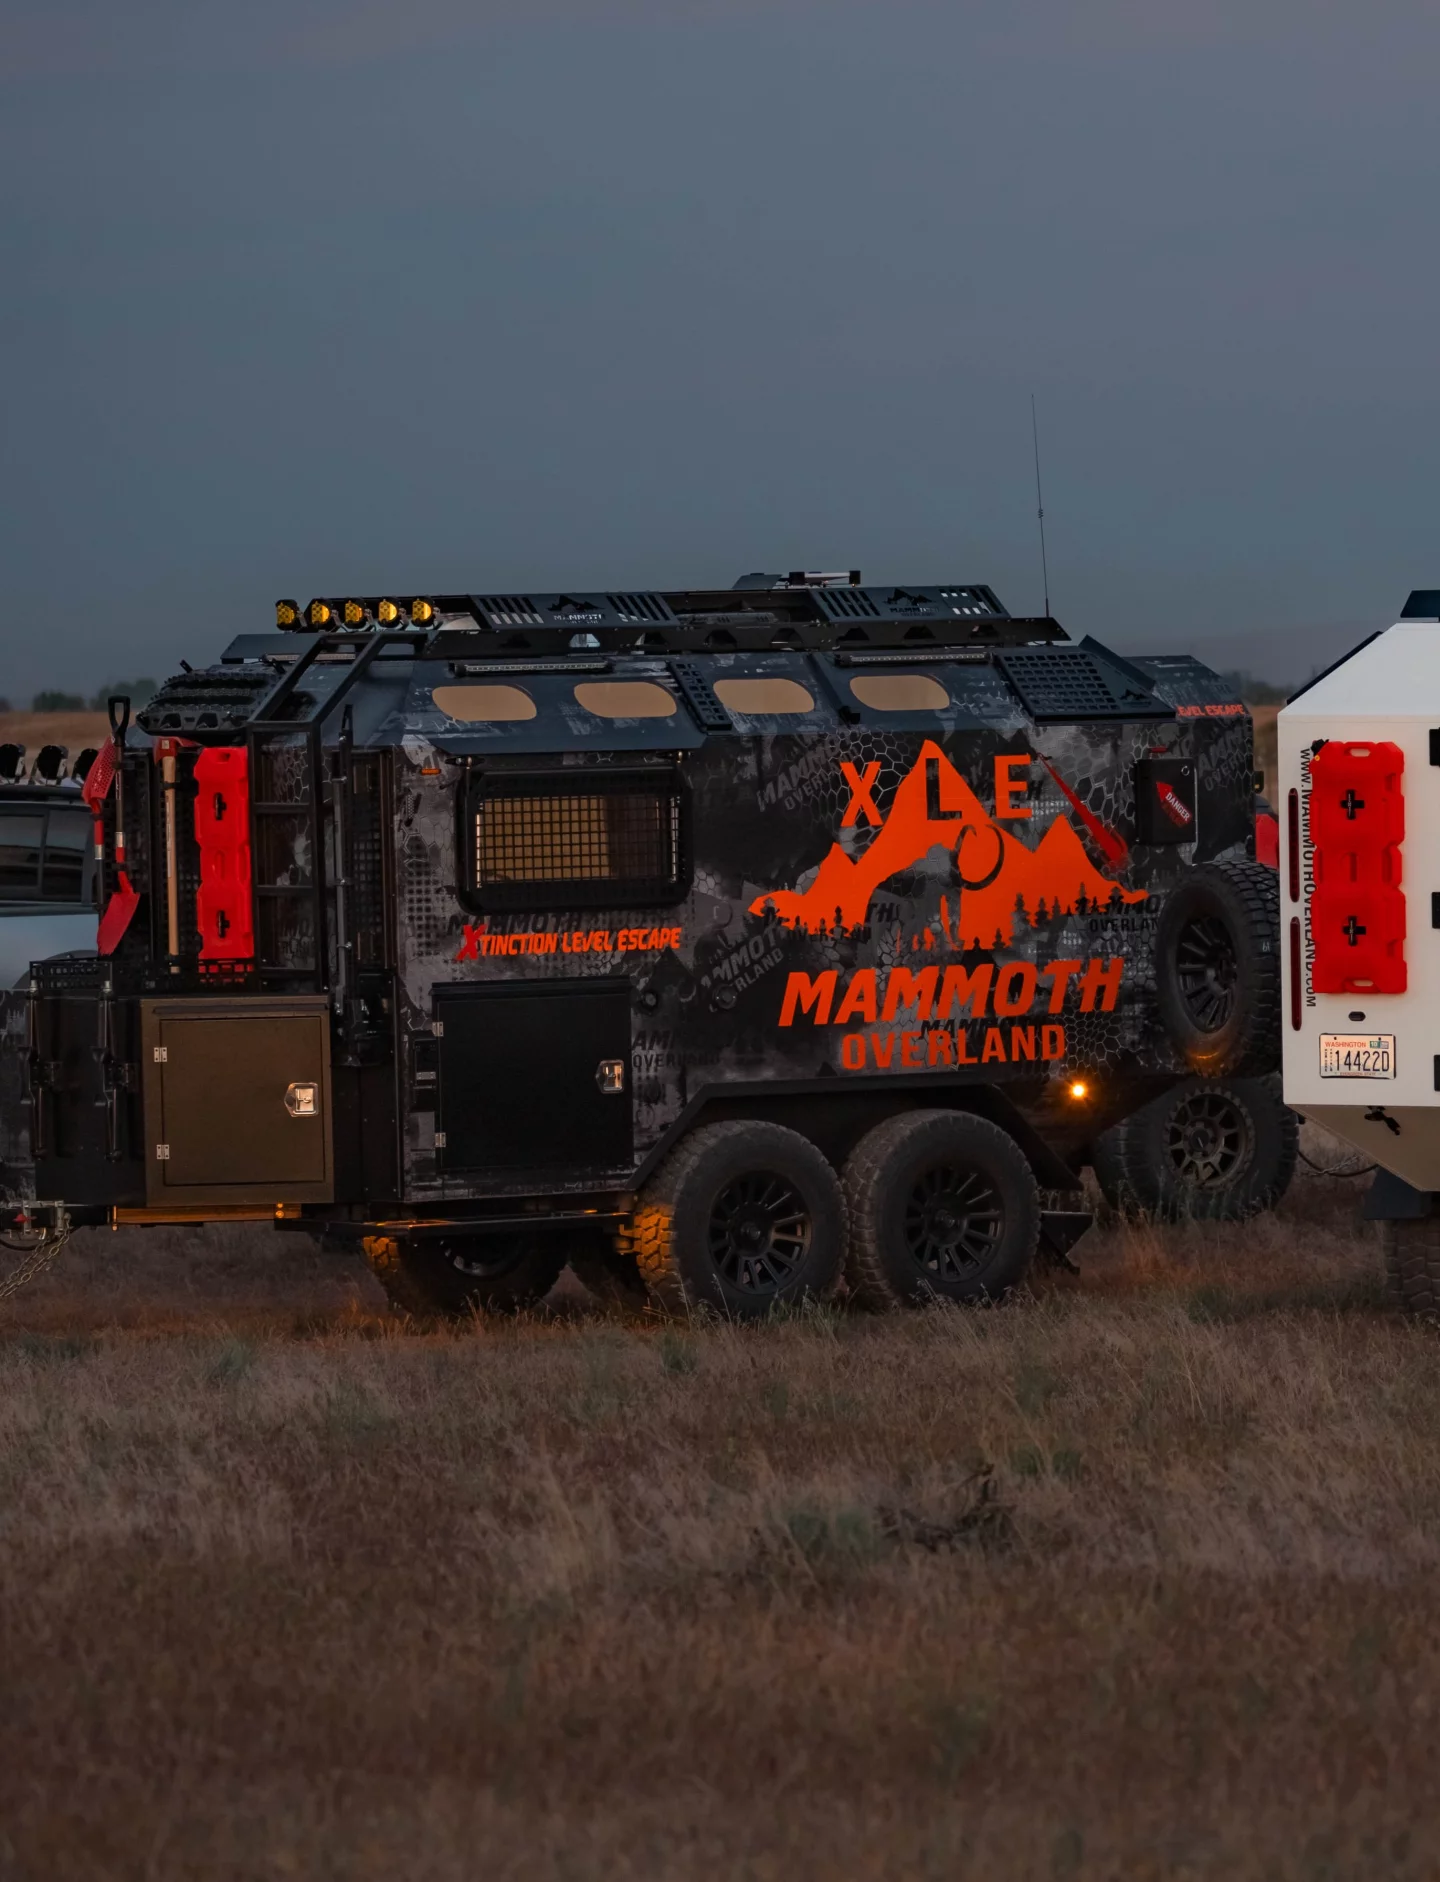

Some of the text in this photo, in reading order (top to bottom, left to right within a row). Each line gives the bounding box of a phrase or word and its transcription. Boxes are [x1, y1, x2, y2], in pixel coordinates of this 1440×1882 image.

[1204, 704, 1245, 715] ESCAPE
[1165, 792, 1190, 821] DANGER
[561, 930, 611, 954] LEVEL
[617, 927, 682, 951] ESCAPE
[778, 958, 1124, 1027] MAMMOTH
[841, 1025, 1066, 1070] OVERLAND
[1335, 1050, 1389, 1072] 14422D
